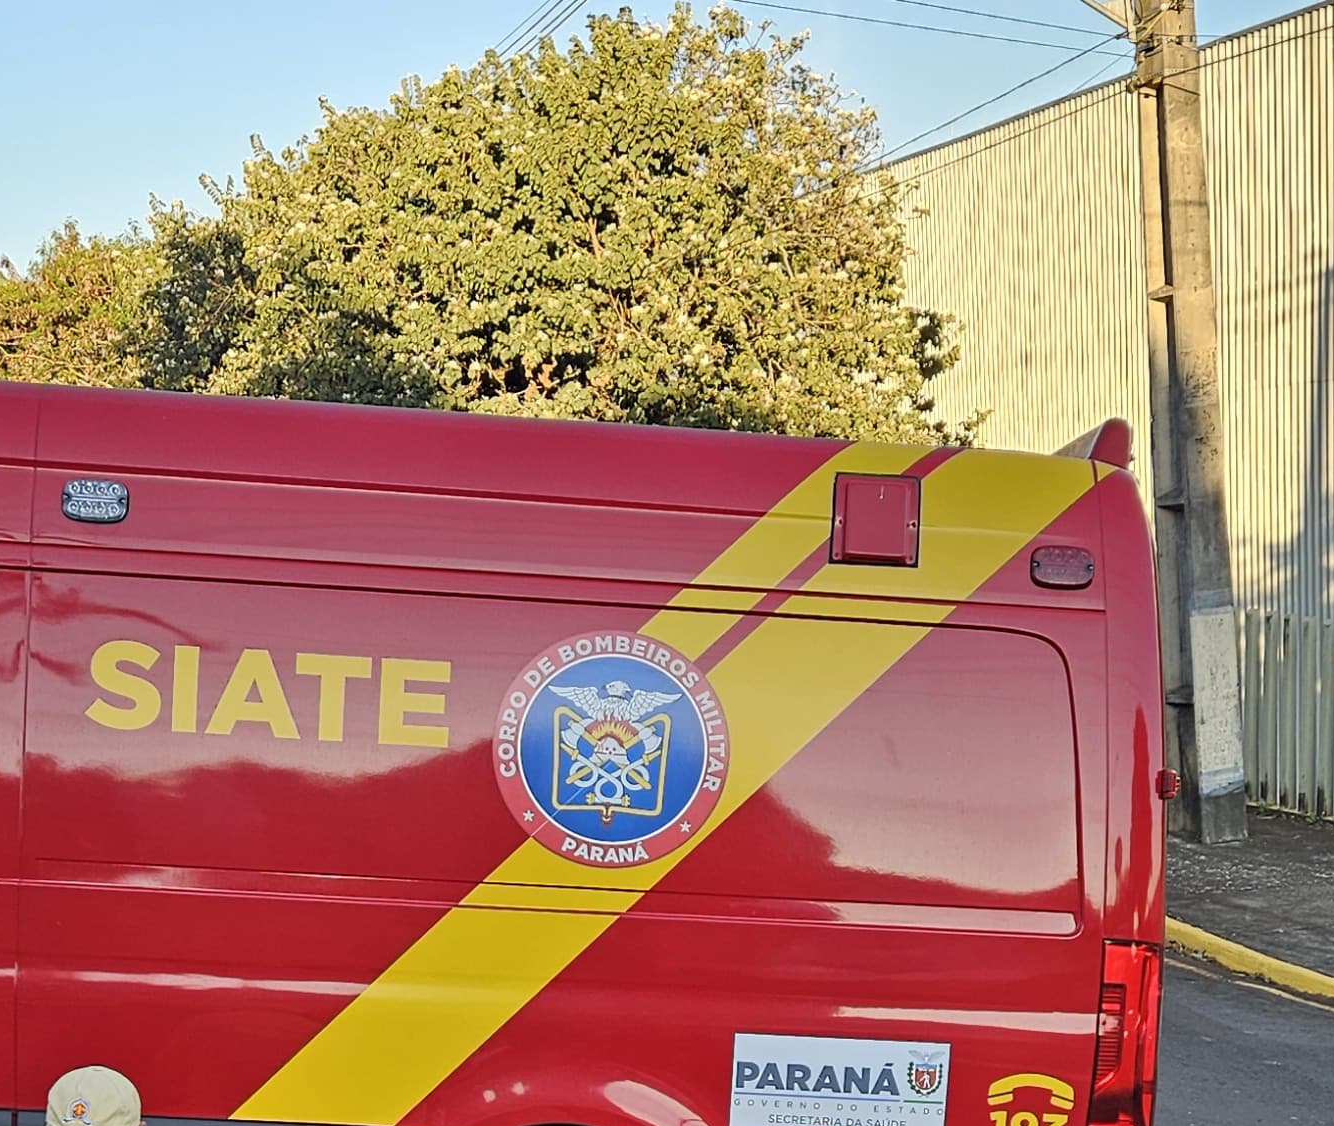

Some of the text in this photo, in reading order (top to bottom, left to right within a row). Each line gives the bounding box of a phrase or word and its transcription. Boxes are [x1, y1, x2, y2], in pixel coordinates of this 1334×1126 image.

[84, 639, 452, 748] SIATE
[497, 635, 726, 793] CORPO DE BOMBEIROS MILITAR
[561, 837, 649, 864] PARANÁ
[735, 1061, 900, 1096] PARANÁ
[734, 1099, 944, 1116] GOVERNO DO ESTADO
[768, 1114, 843, 1126] SECRETARIA
